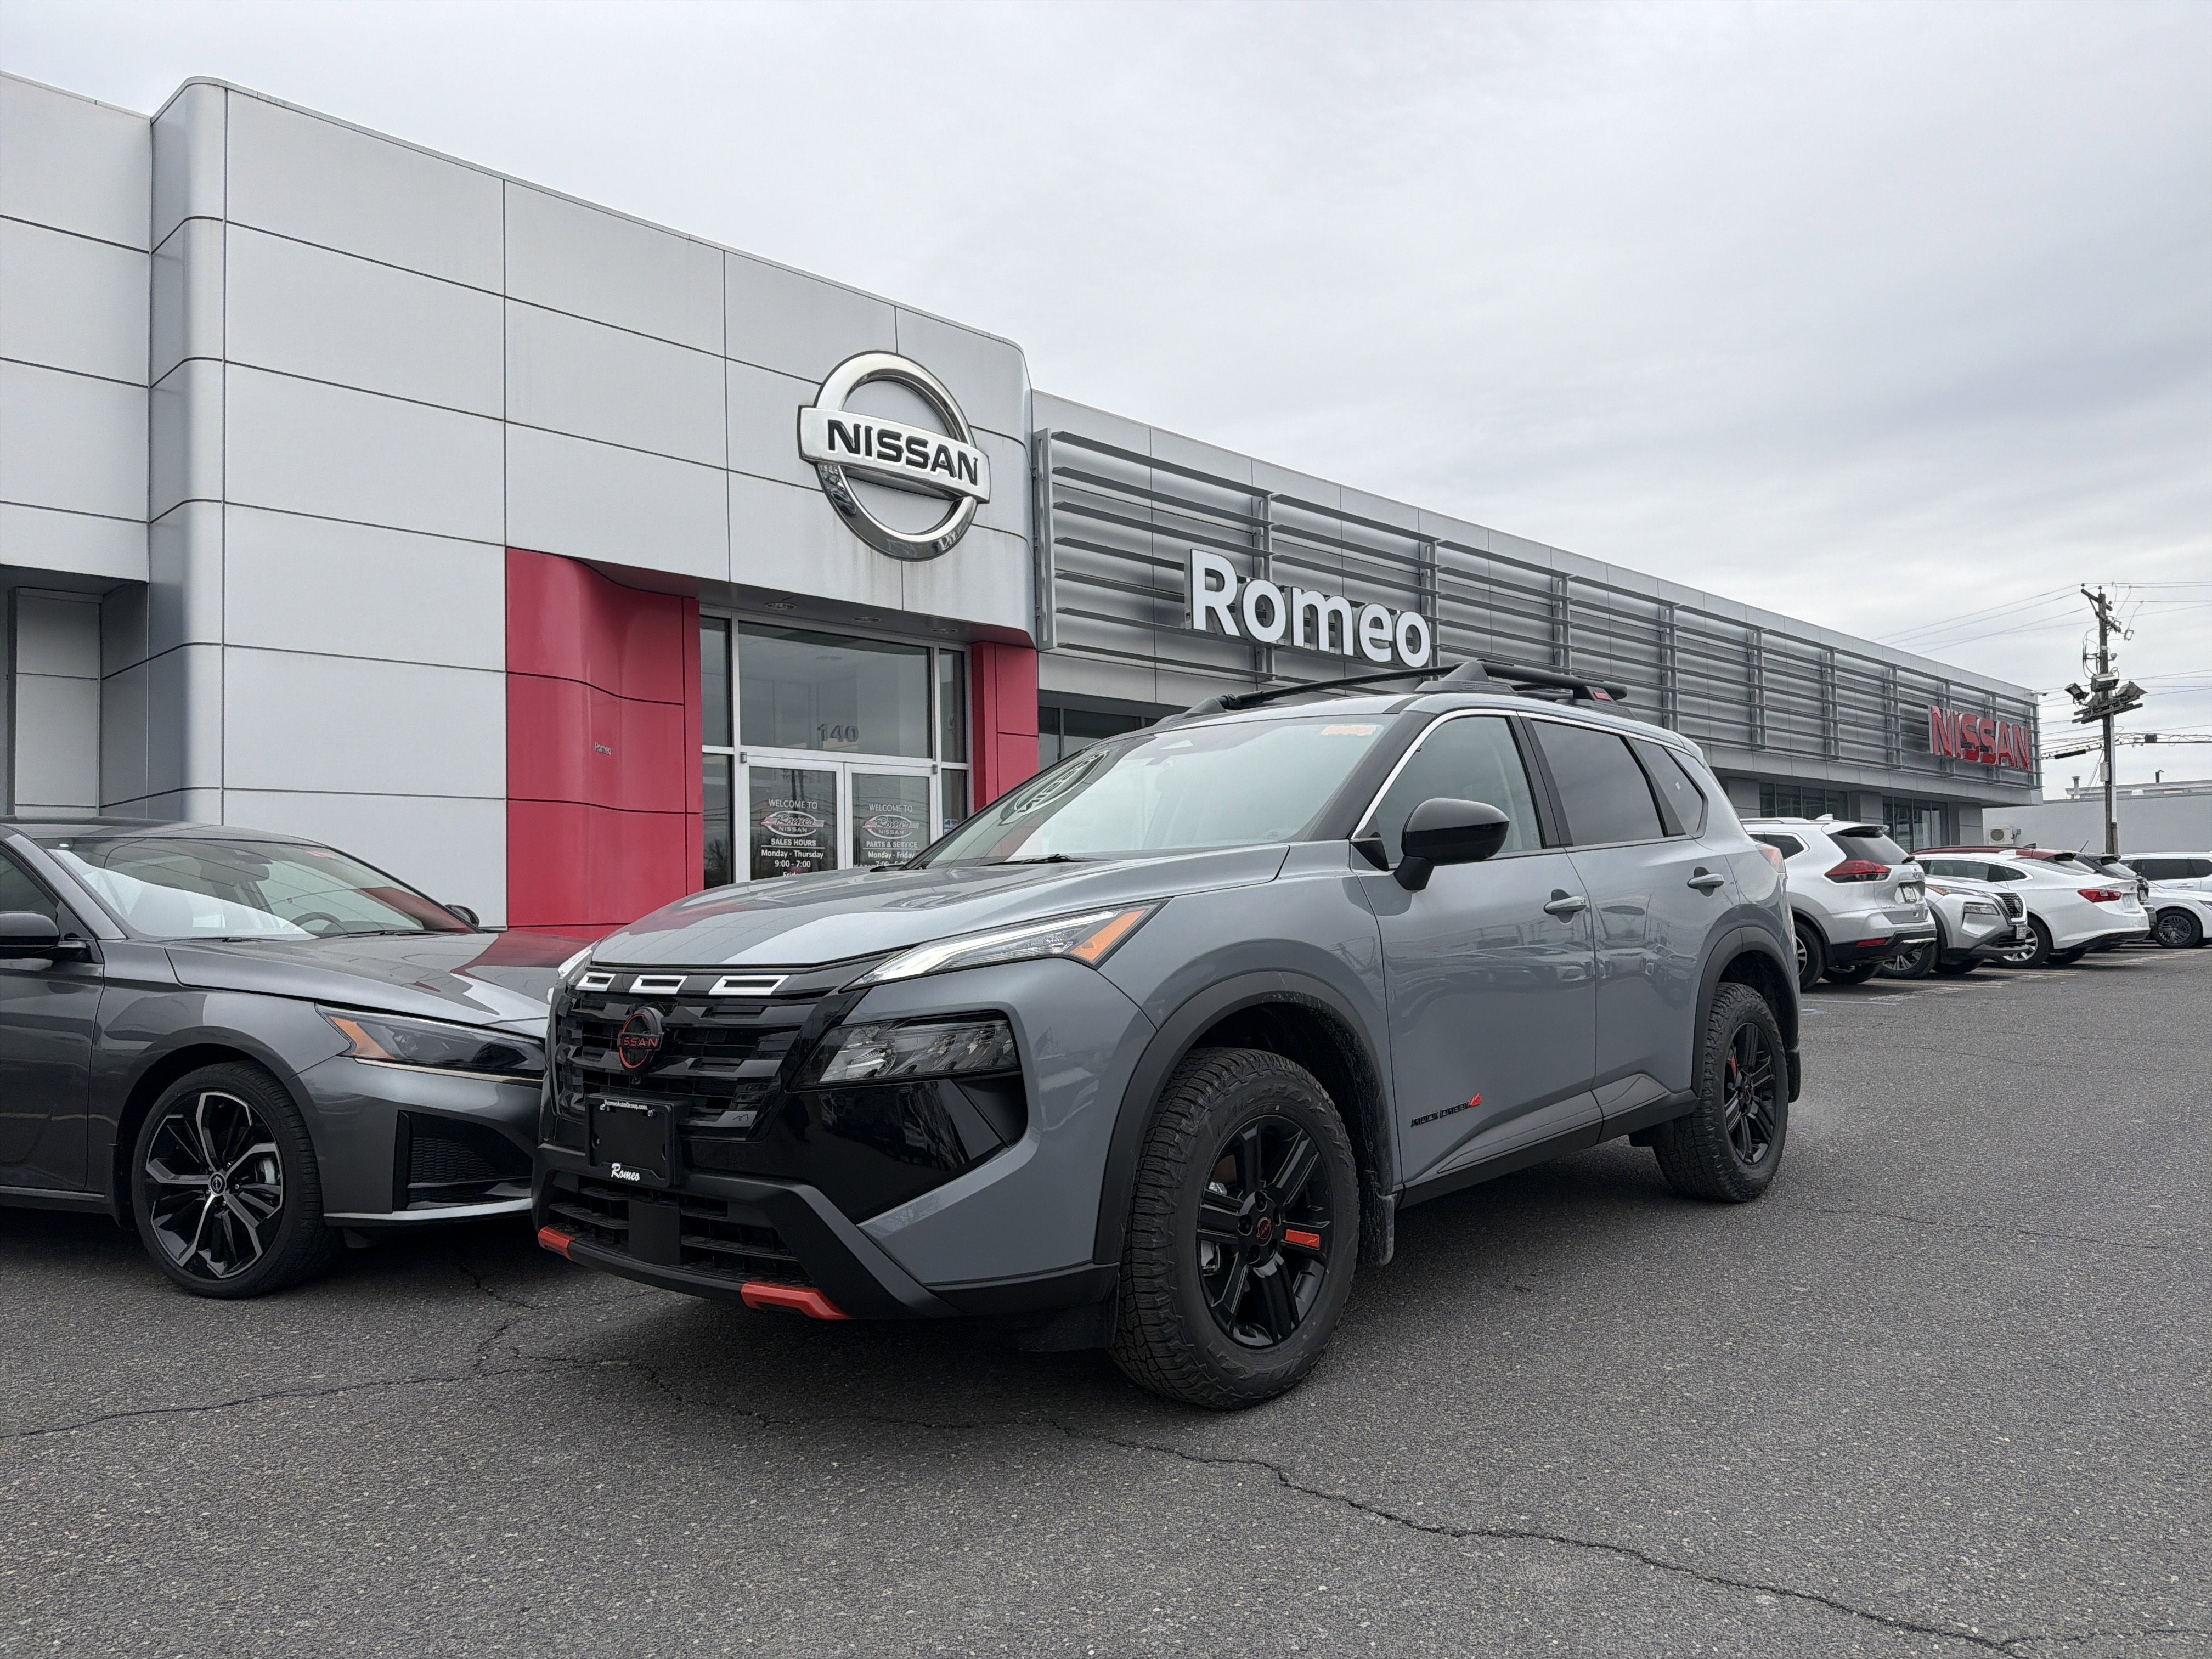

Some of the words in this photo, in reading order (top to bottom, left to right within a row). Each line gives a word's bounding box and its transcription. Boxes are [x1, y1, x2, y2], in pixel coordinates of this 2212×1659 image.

[827, 419, 978, 486] NISSAN
[1188, 548, 1431, 668] Romeo
[817, 723, 859, 742] 140
[1929, 706, 2030, 770] NISSAN
[595, 742, 611, 755] Romeo
[768, 799, 805, 809] WELCOME
[807, 801, 817, 809] TO
[868, 804, 902, 812] WELCOME
[772, 812, 815, 826] Romeo
[874, 816, 911, 828] Romeo
[761, 849, 788, 859] Monday
[794, 850, 824, 859] Thursday
[868, 851, 891, 859] Monday
[611, 1163, 640, 1181] Romeo
